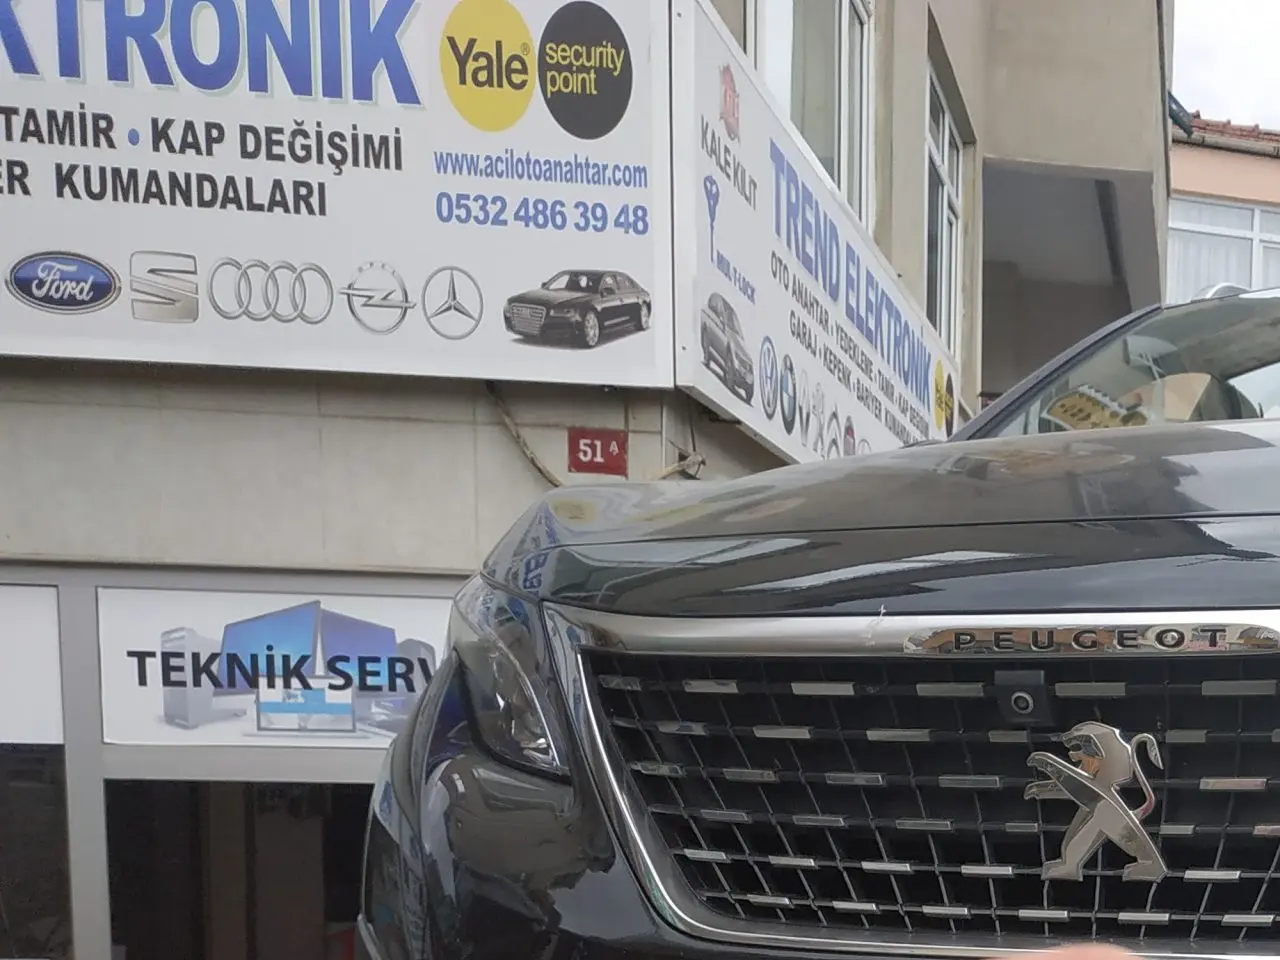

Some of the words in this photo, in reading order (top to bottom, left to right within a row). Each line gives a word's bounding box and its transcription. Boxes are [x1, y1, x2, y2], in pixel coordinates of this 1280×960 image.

[446, 36, 529, 91] Yale
[545, 41, 625, 76] security
[546, 67, 598, 98] point
[0, 102, 117, 149] TAMİR
[150, 117, 225, 156] KAP
[239, 119, 403, 176] DEĞİŞİMİ
[701, 114, 732, 182] KALE
[0, 159, 31, 196] R
[54, 162, 328, 216] KUMANDALARI
[434, 149, 649, 188] www.acilotoanahtar.com
[436, 192, 508, 226] 0532
[513, 197, 567, 230] 486
[573, 201, 609, 232] 39
[614, 204, 649, 235] 48
[769, 136, 840, 303] TREND
[32, 261, 95, 301] Ford
[771, 250, 789, 292] OTO
[792, 273, 829, 333] ANAHTAR
[789, 309, 817, 358] GARAJ
[578, 438, 605, 463] 51
[953, 626, 1230, 652] PEUGEOT
[127, 645, 313, 690] TEKNİK
